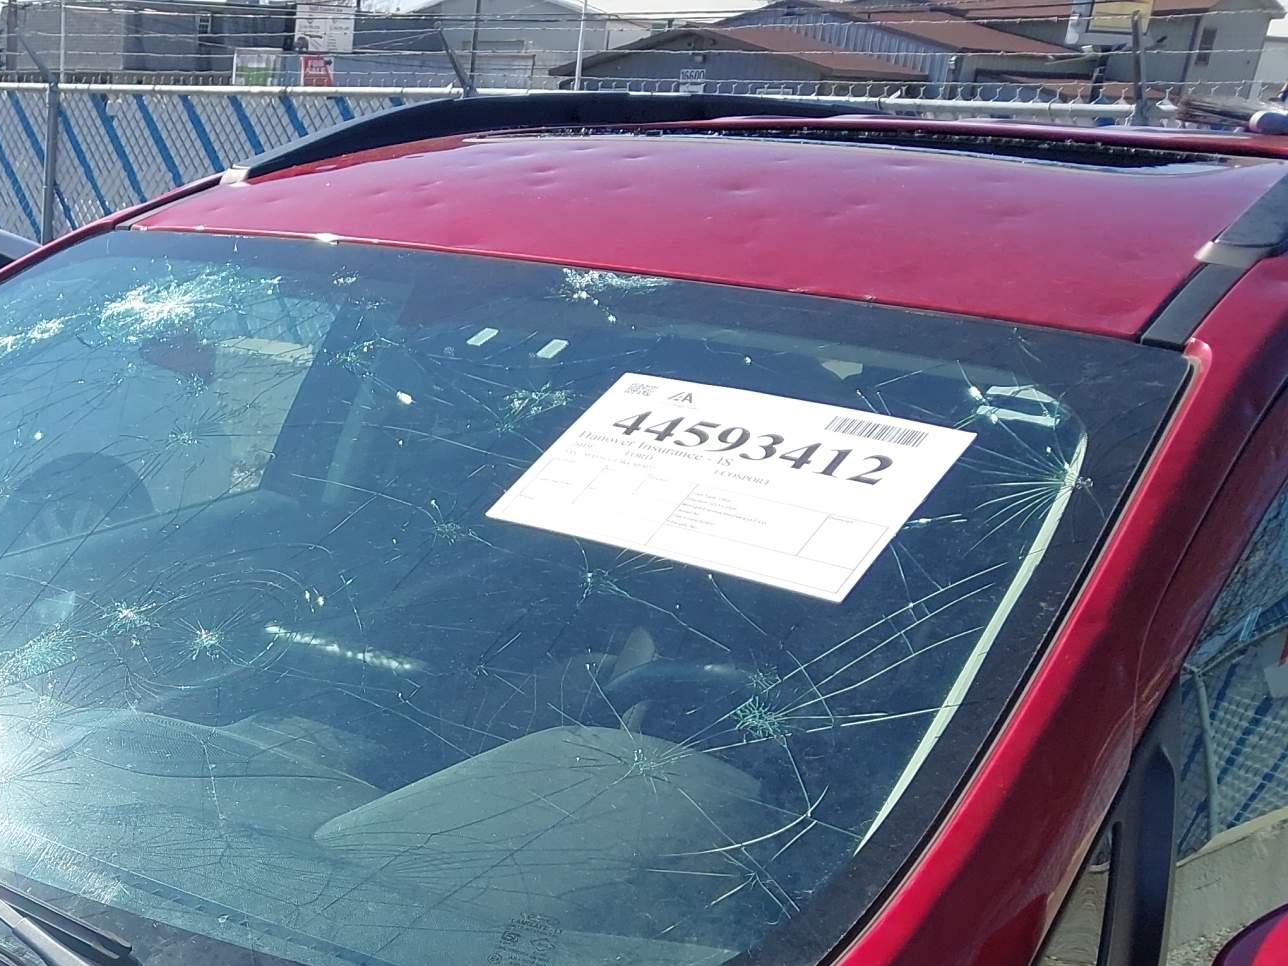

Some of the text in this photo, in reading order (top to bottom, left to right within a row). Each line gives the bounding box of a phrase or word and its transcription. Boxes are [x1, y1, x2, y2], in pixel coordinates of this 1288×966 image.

[578, 430, 635, 448] Hanover
[639, 438, 704, 462] Insurance
[612, 410, 893, 486] 44593412
